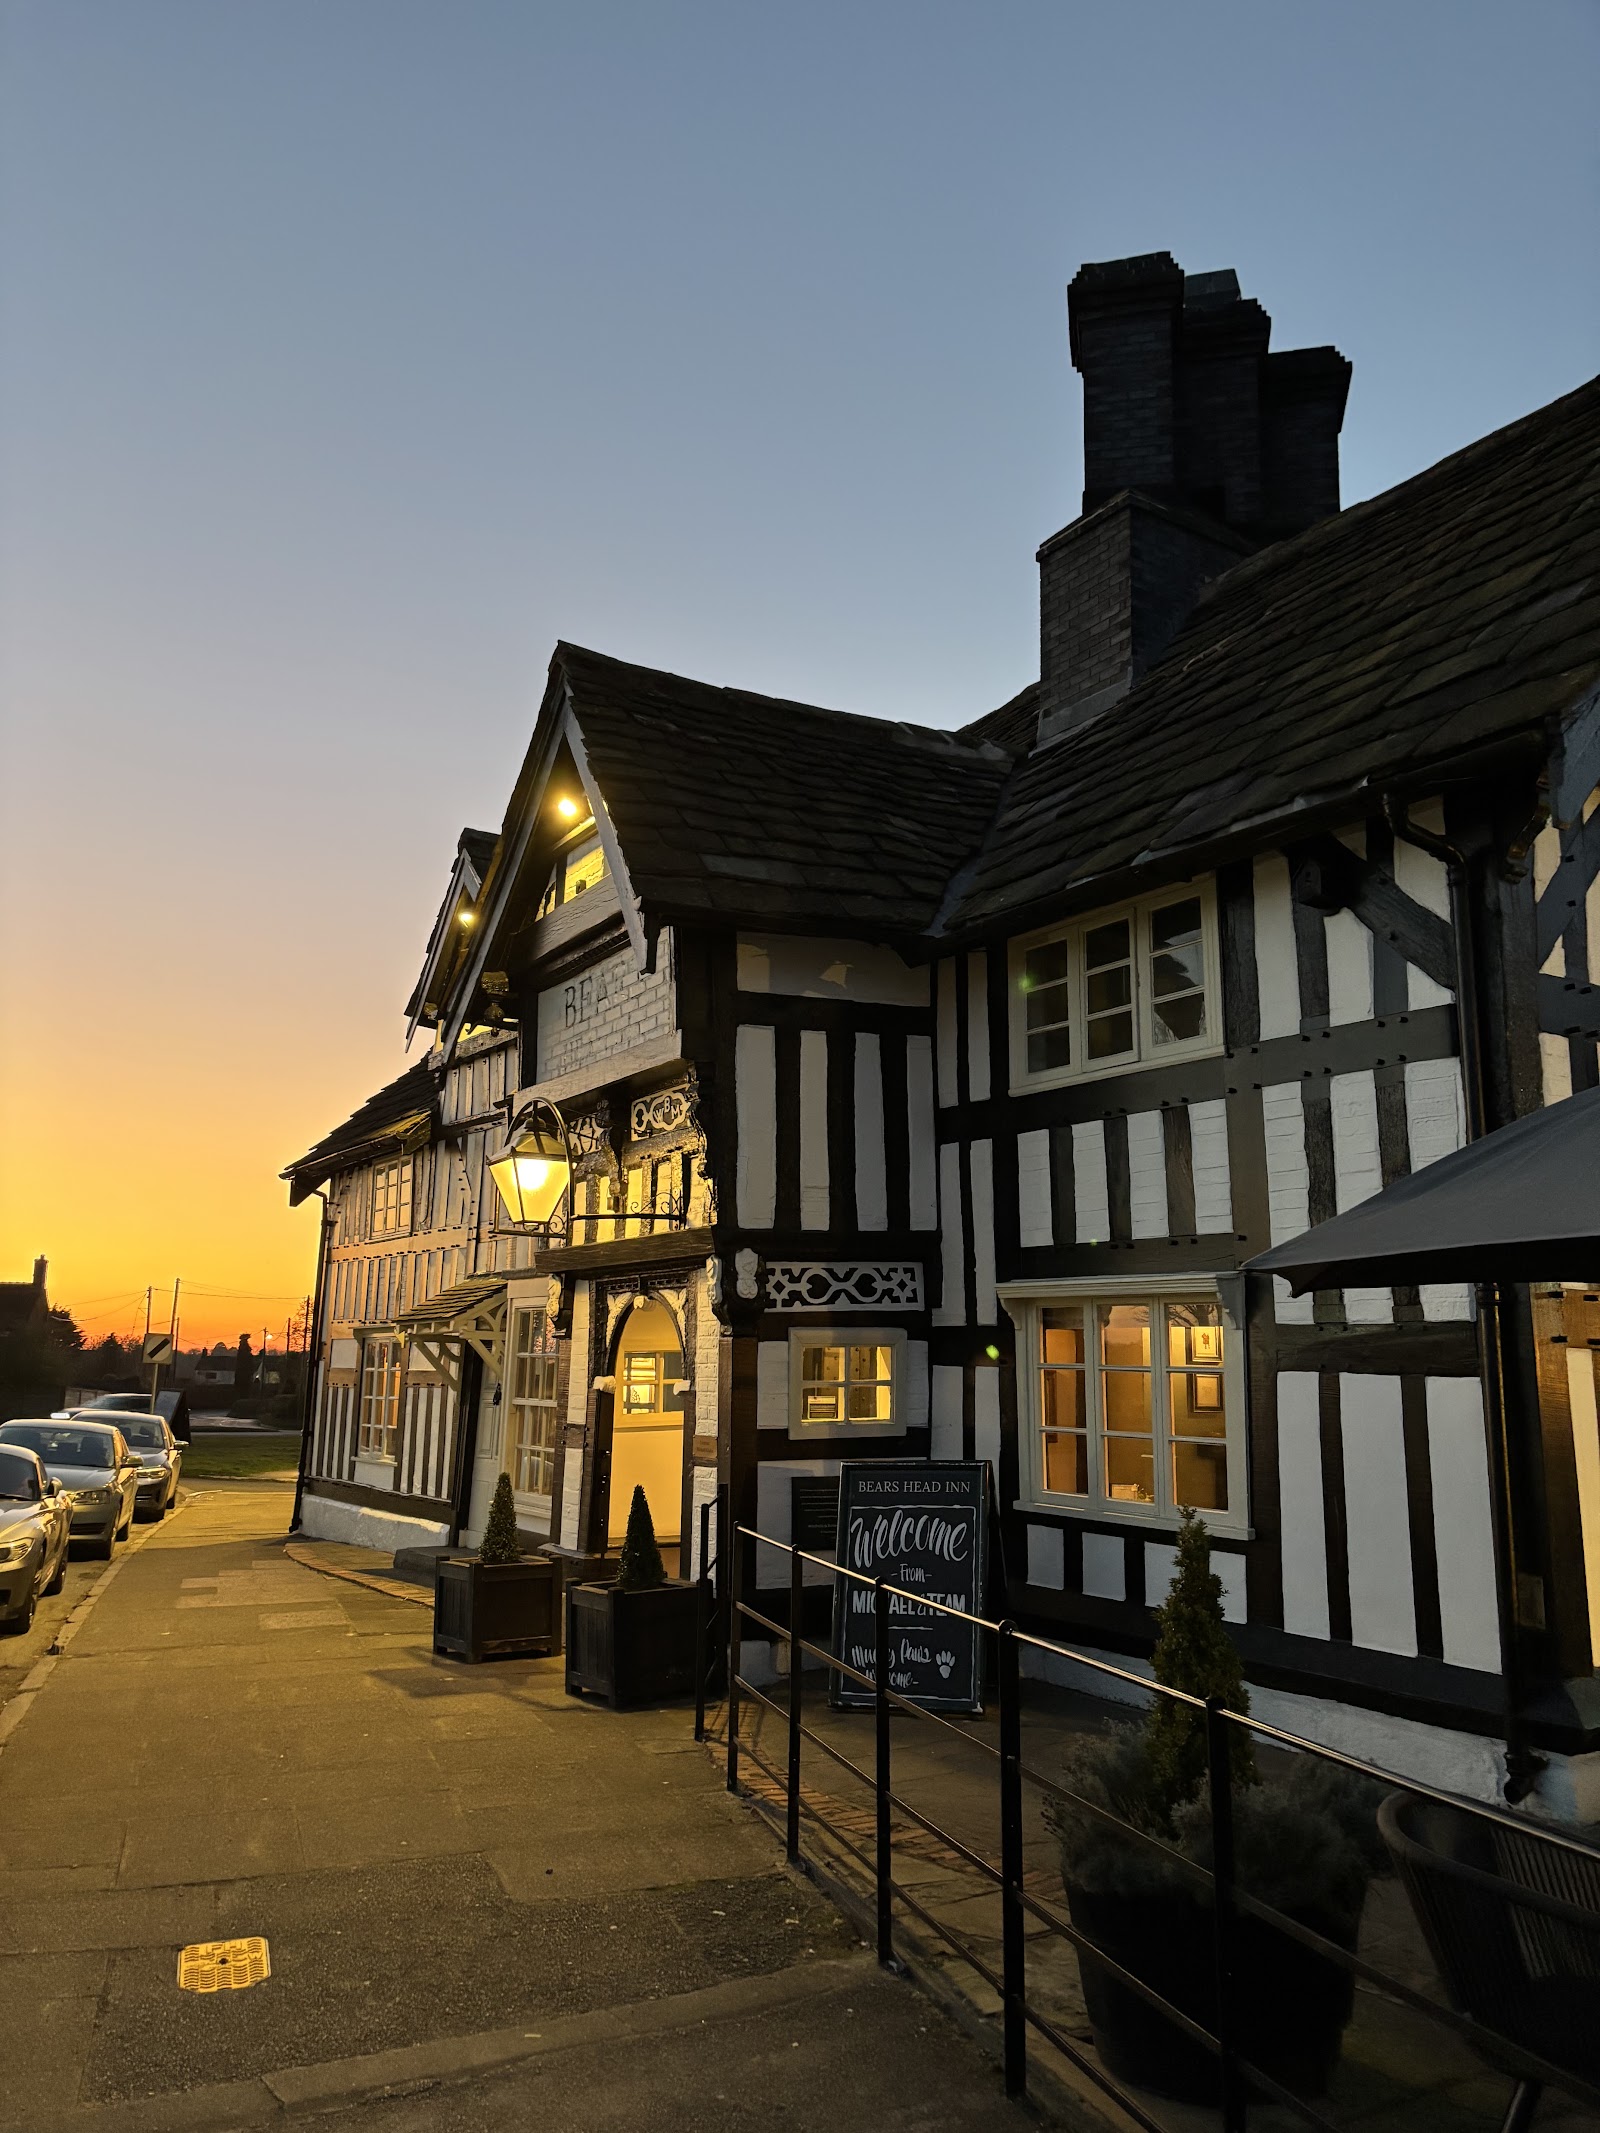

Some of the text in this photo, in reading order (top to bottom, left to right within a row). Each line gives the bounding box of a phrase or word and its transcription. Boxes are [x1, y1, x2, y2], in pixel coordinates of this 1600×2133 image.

[858, 1481, 970, 1493] BEARS HEAD INN
[850, 1509, 968, 1568] Welcome
[852, 1590, 915, 1616] MICAEL
